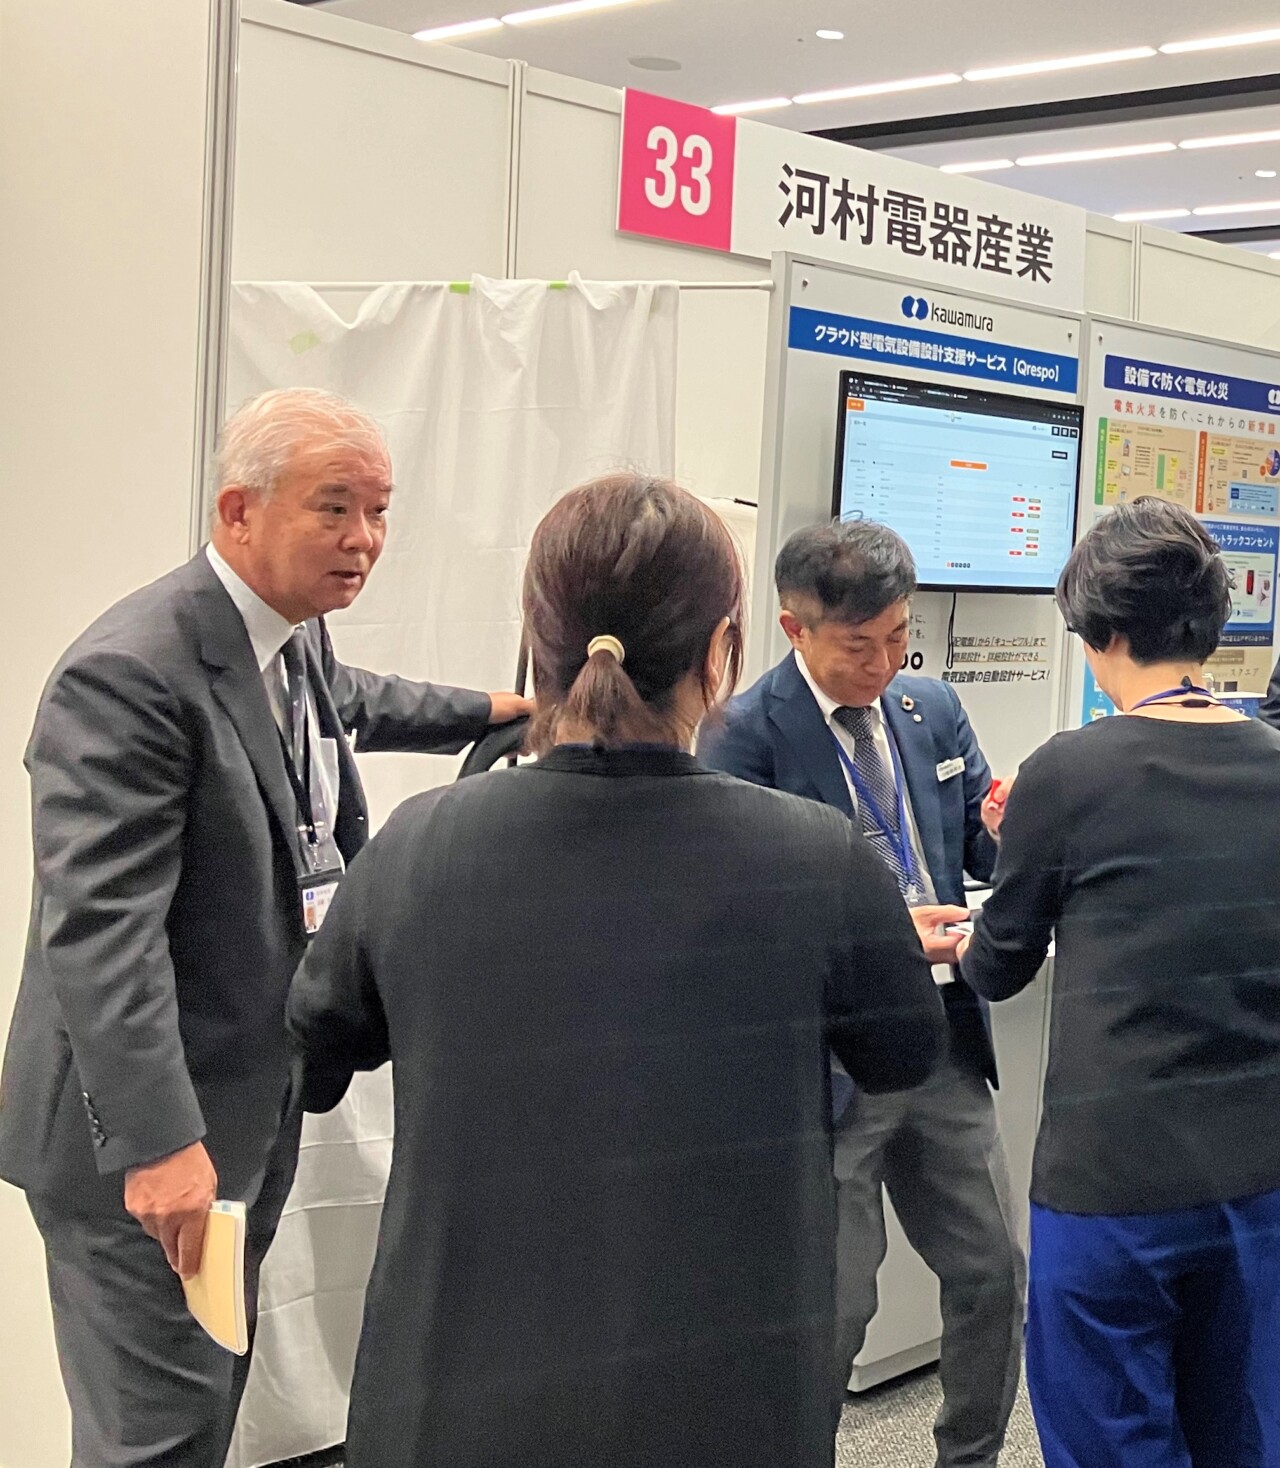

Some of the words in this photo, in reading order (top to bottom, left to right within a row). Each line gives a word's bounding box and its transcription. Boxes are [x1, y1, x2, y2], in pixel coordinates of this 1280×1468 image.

[644, 125, 713, 216] 33
[778, 163, 1054, 284] 河村電器産業
[1124, 365, 1229, 401] 設備で防ぐ電気火災
